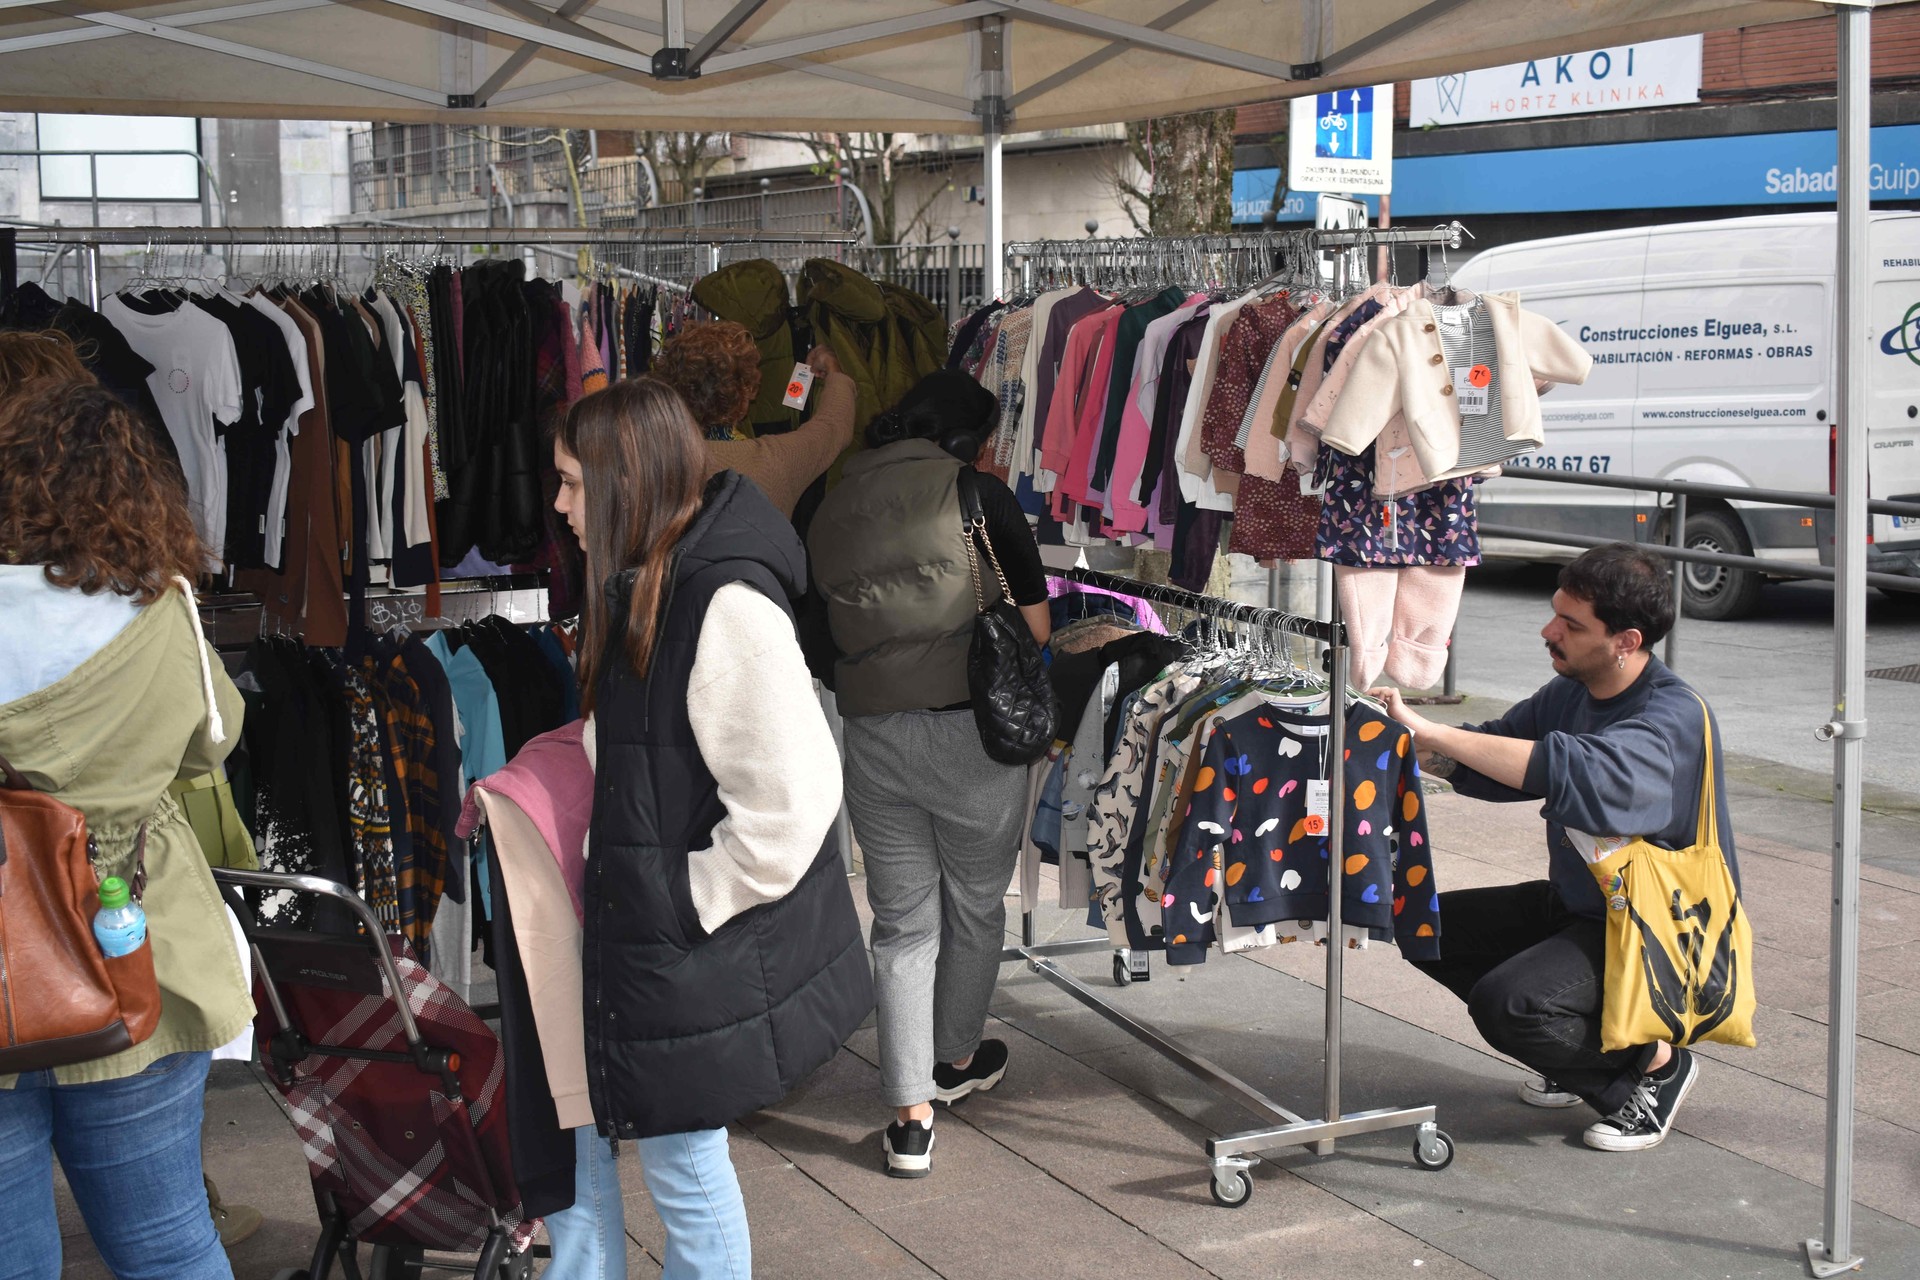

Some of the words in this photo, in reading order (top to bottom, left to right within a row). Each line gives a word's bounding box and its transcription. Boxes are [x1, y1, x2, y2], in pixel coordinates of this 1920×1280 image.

[1520, 48, 1635, 88] AKOI
[1490, 94, 1557, 113] HORTZ
[1571, 84, 1665, 106] KLINIKA
[1765, 164, 1838, 194] Sabad
[1347, 208, 1365, 230] WC
[1580, 324, 1699, 343] Construcciones
[1704, 318, 1768, 340] Elguea,
[1773, 324, 1798, 334] S.L.
[1590, 347, 1673, 365] HABILITACIÓN
[1684, 347, 1754, 361] REFORMAS
[1766, 345, 1813, 358] OBRAS
[1642, 407, 1806, 420] www.construccioneselguea.com
[1873, 440, 1914, 449] CRAFTER
[1536, 456, 1557, 470] 28
[1562, 456, 1583, 472] 67
[1589, 455, 1611, 473] 67
